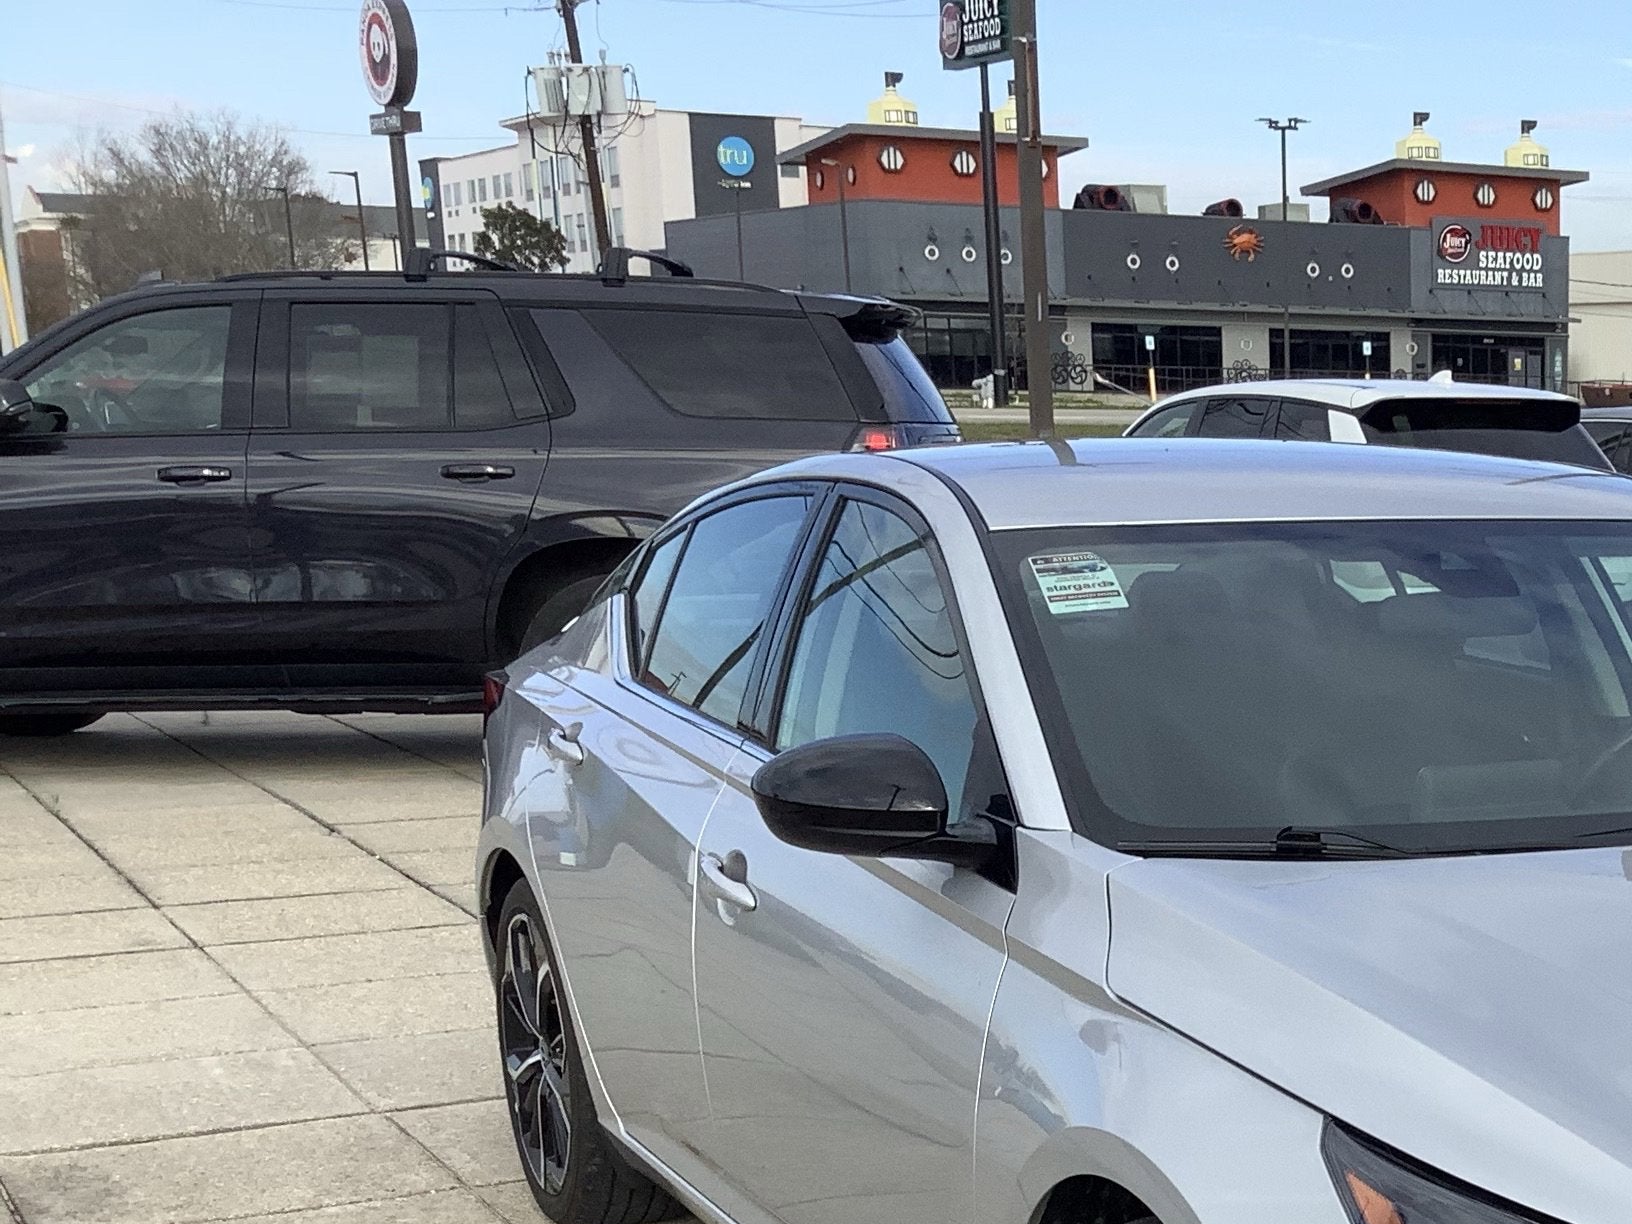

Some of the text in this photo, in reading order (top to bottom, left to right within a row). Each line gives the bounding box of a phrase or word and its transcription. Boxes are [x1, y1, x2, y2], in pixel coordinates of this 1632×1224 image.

[962, 0, 999, 23] JUICY
[963, 17, 1001, 43] SEAFOOD
[718, 144, 747, 165] tru
[1476, 224, 1542, 254] JUICY
[1479, 251, 1543, 270] SEAFOOD
[1437, 268, 1543, 287] RESTAURANT & BAR
